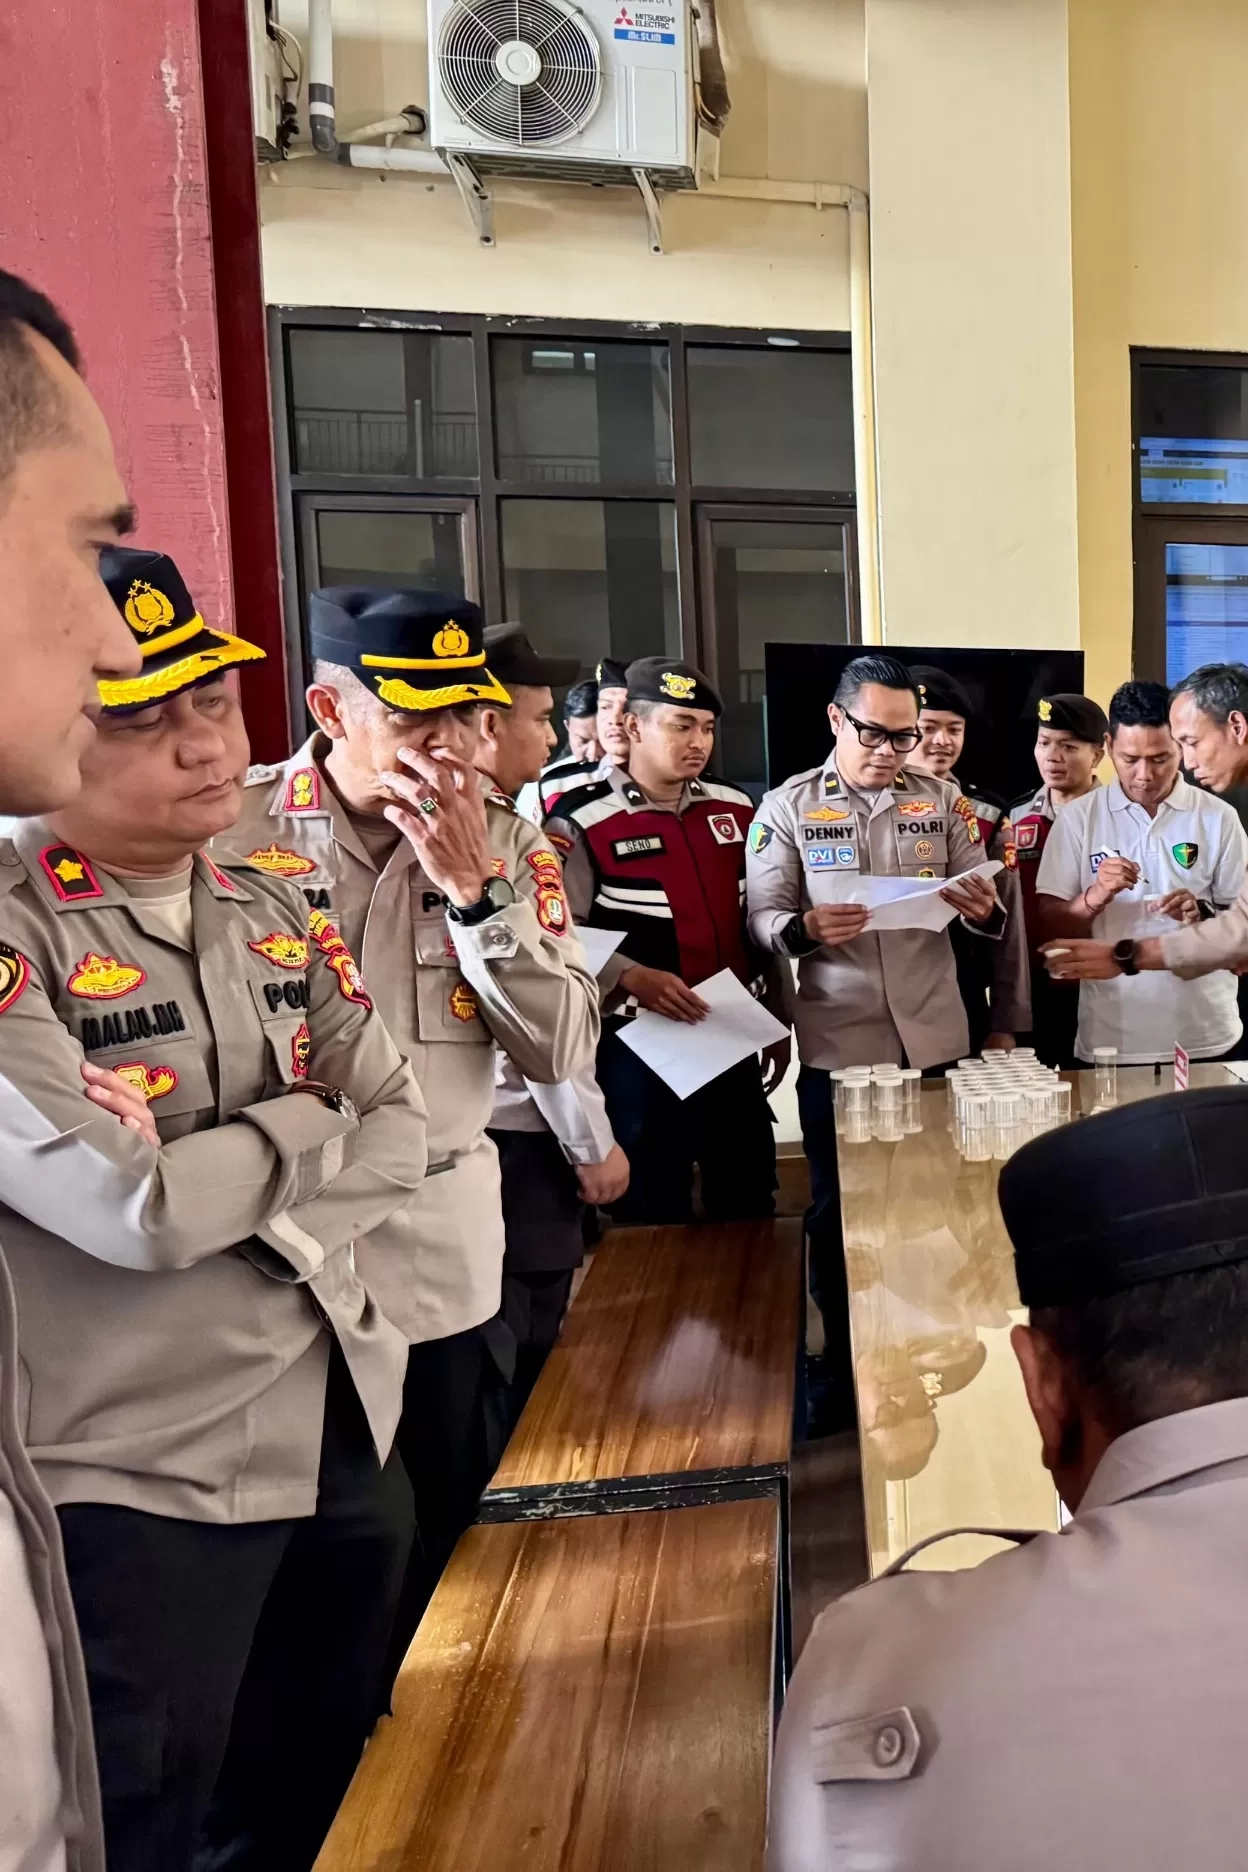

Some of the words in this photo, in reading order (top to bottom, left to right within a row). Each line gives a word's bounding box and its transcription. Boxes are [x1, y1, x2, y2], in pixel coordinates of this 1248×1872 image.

[635, 13, 675, 23] MITSUBISHI
[635, 20, 670, 29] ELECTRIC
[804, 826, 853, 841] DENNY
[898, 820, 943, 835] POLRI
[808, 849, 833, 861] DVI
